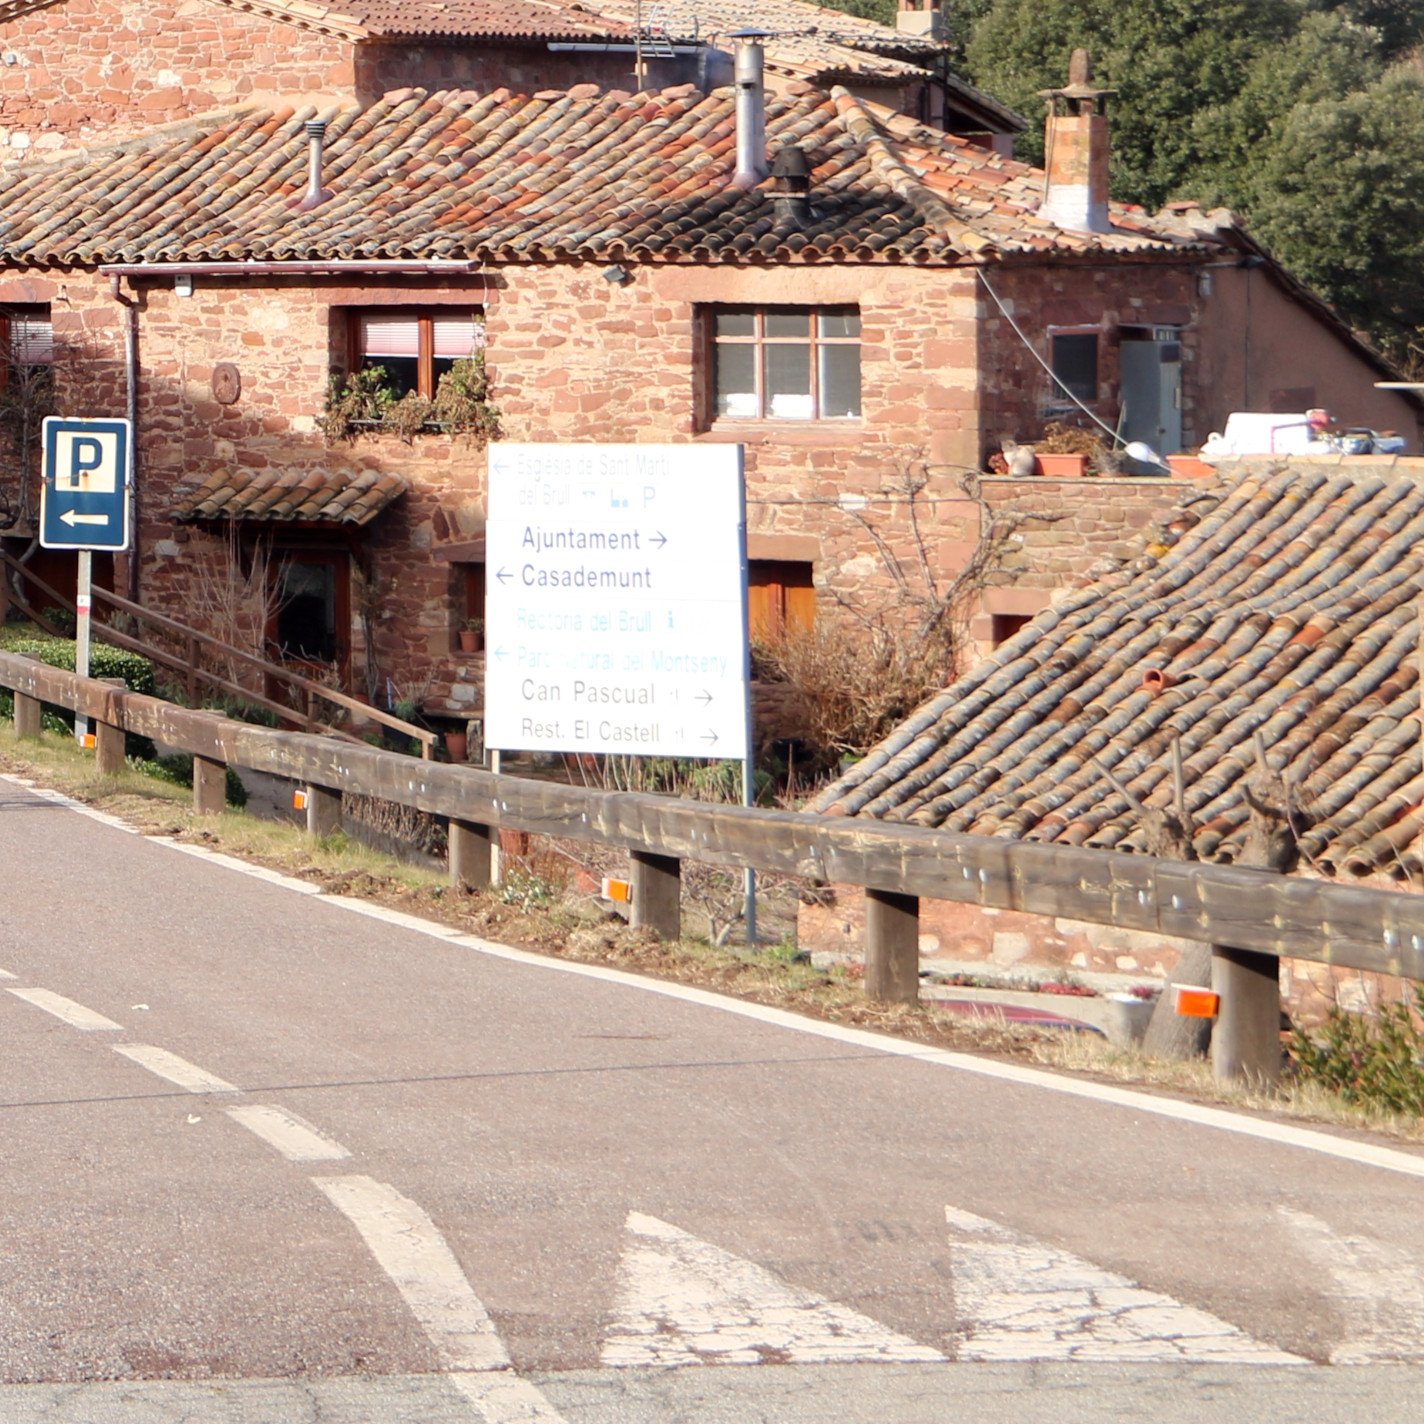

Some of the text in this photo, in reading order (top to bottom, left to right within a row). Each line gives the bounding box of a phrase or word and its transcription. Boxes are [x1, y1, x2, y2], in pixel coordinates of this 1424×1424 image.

[70, 437, 103, 487] P
[600, 453, 629, 476] Sant
[521, 525, 641, 553] Ajuntament
[521, 562, 652, 588] Casademunt
[521, 678, 655, 705] Can Pascual
[521, 717, 661, 743] Rest. El Castell
